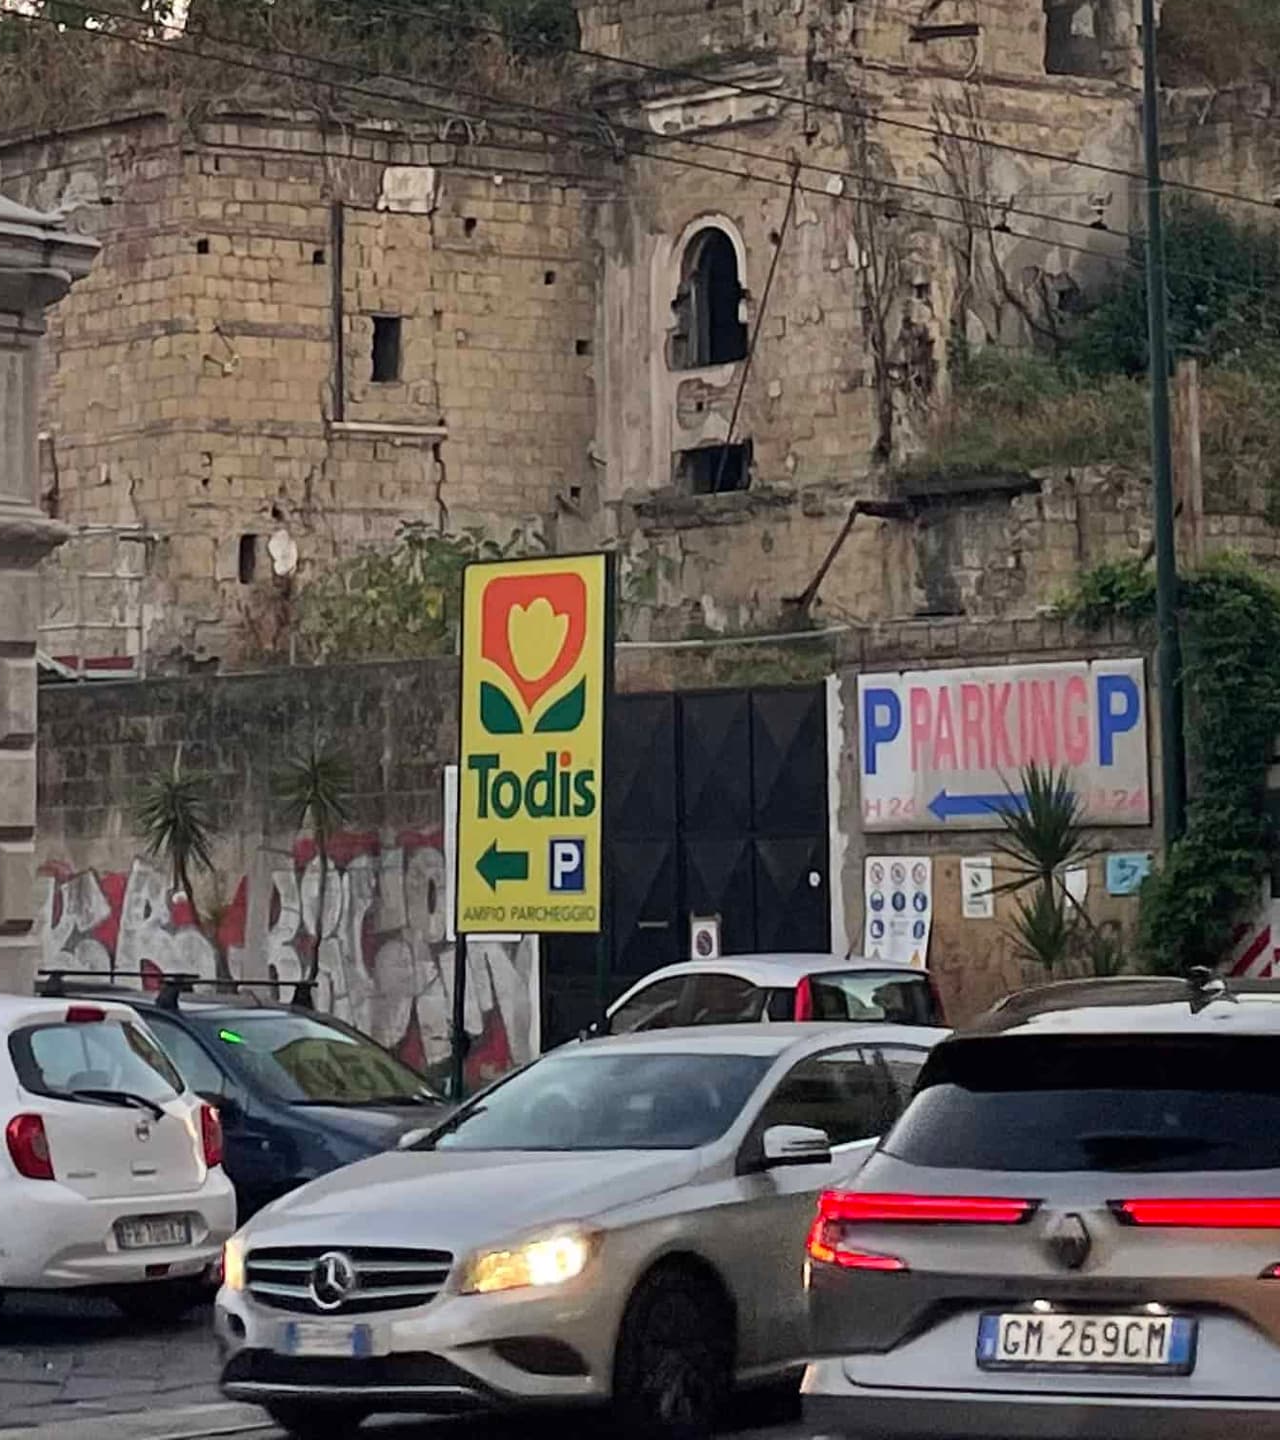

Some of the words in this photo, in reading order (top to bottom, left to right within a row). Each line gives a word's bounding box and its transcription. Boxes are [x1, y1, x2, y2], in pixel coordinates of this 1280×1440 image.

[864, 688, 902, 775] P
[910, 675, 1089, 772] PARKING
[1097, 674, 1140, 767] P
[467, 750, 597, 820] Todis
[553, 842, 581, 889] P
[510, 905, 597, 923] PARCHEGGIO
[1003, 1319, 1044, 1356] GM
[1056, 1320, 1167, 1359] 269CM
